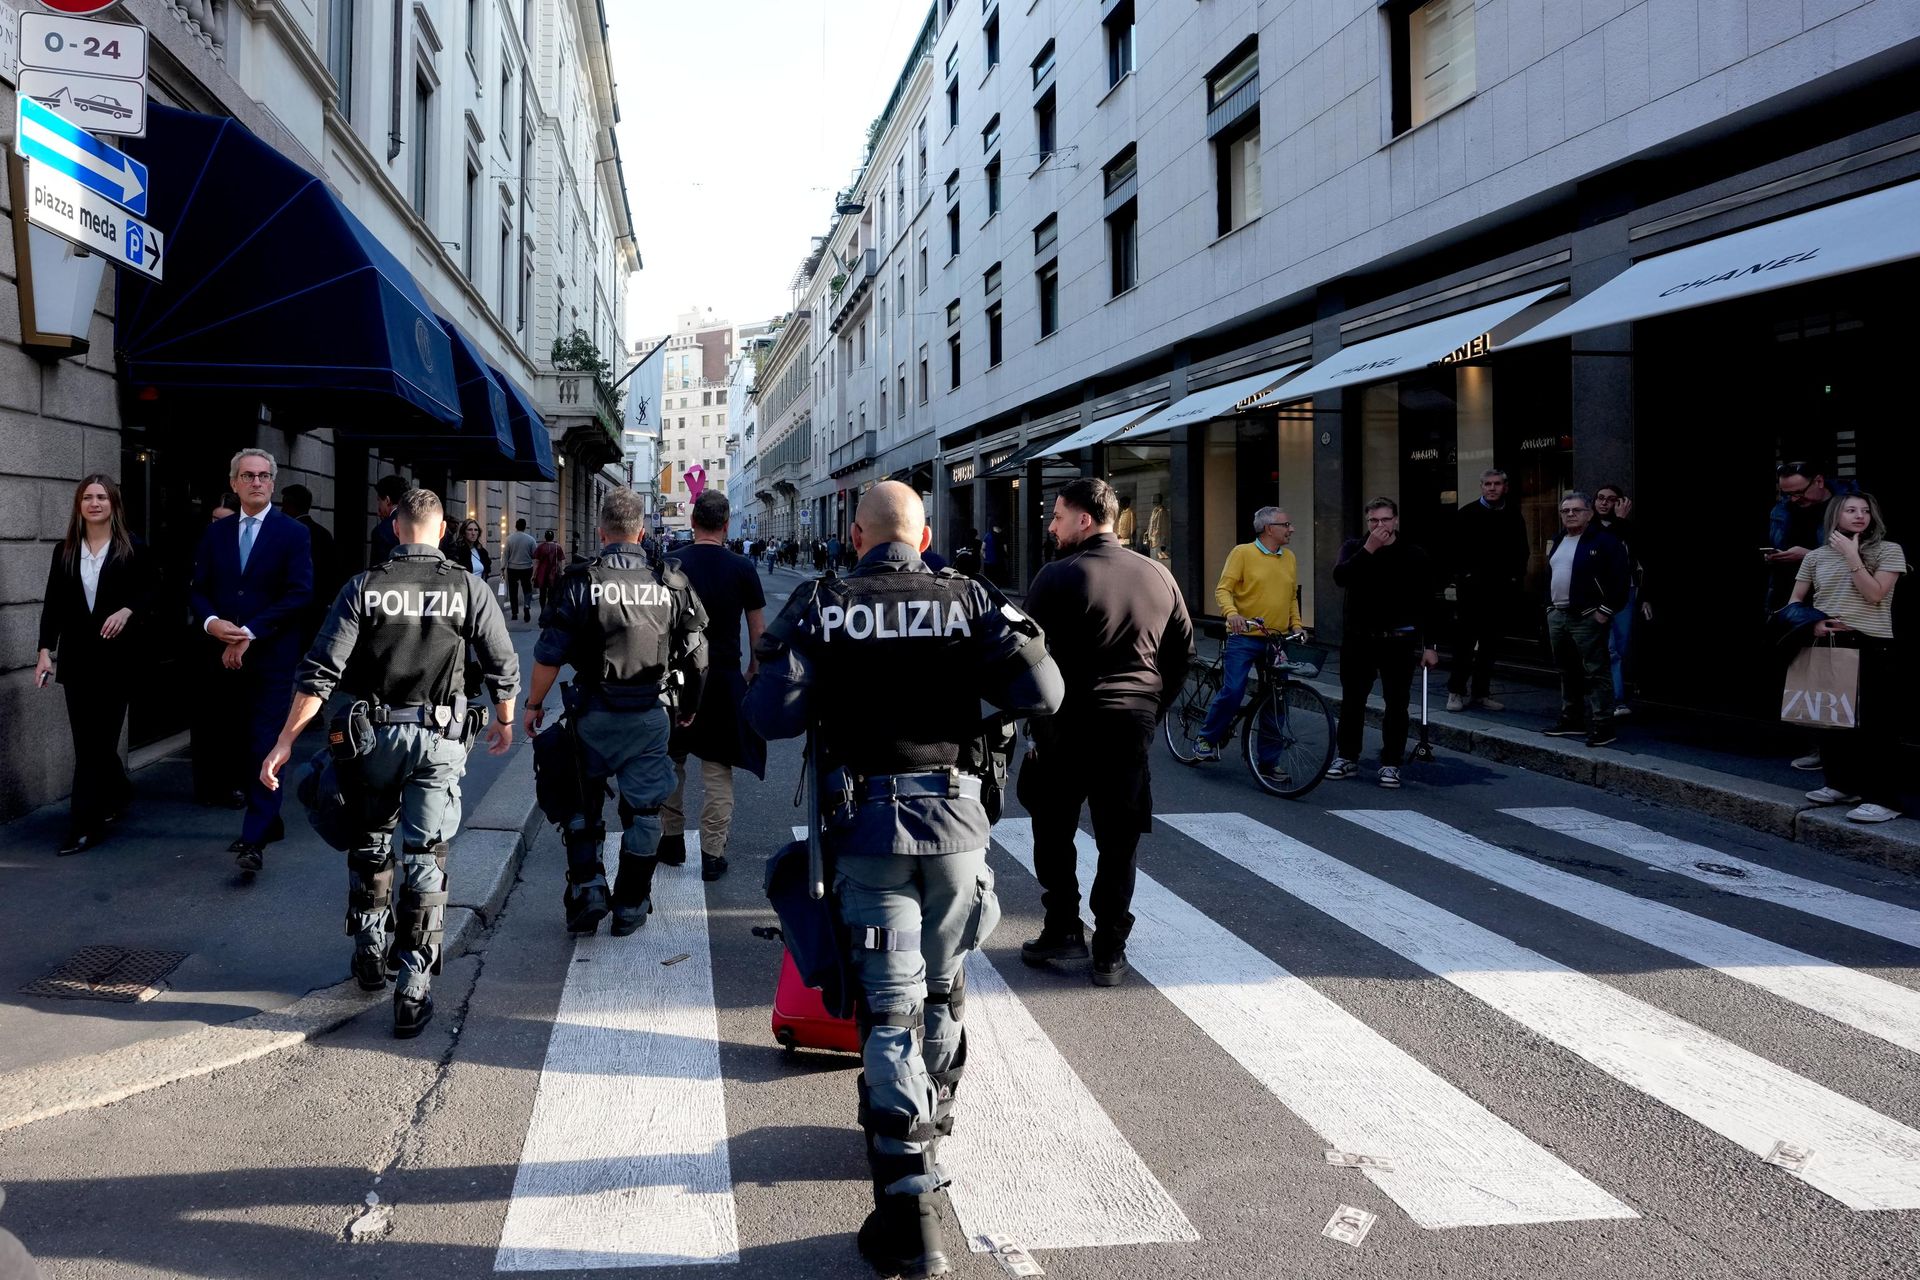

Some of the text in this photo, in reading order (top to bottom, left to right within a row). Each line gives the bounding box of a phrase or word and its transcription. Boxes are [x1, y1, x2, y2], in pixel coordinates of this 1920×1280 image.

[35, 185, 140, 259] piazza meda P
[1659, 248, 1821, 298] CHANEL
[952, 463, 975, 483] GUCCI
[364, 590, 466, 618] POLIZIA
[590, 583, 672, 607] POLIZIA
[822, 600, 972, 642] POLIZIA
[1781, 689, 1855, 725] ZARA
